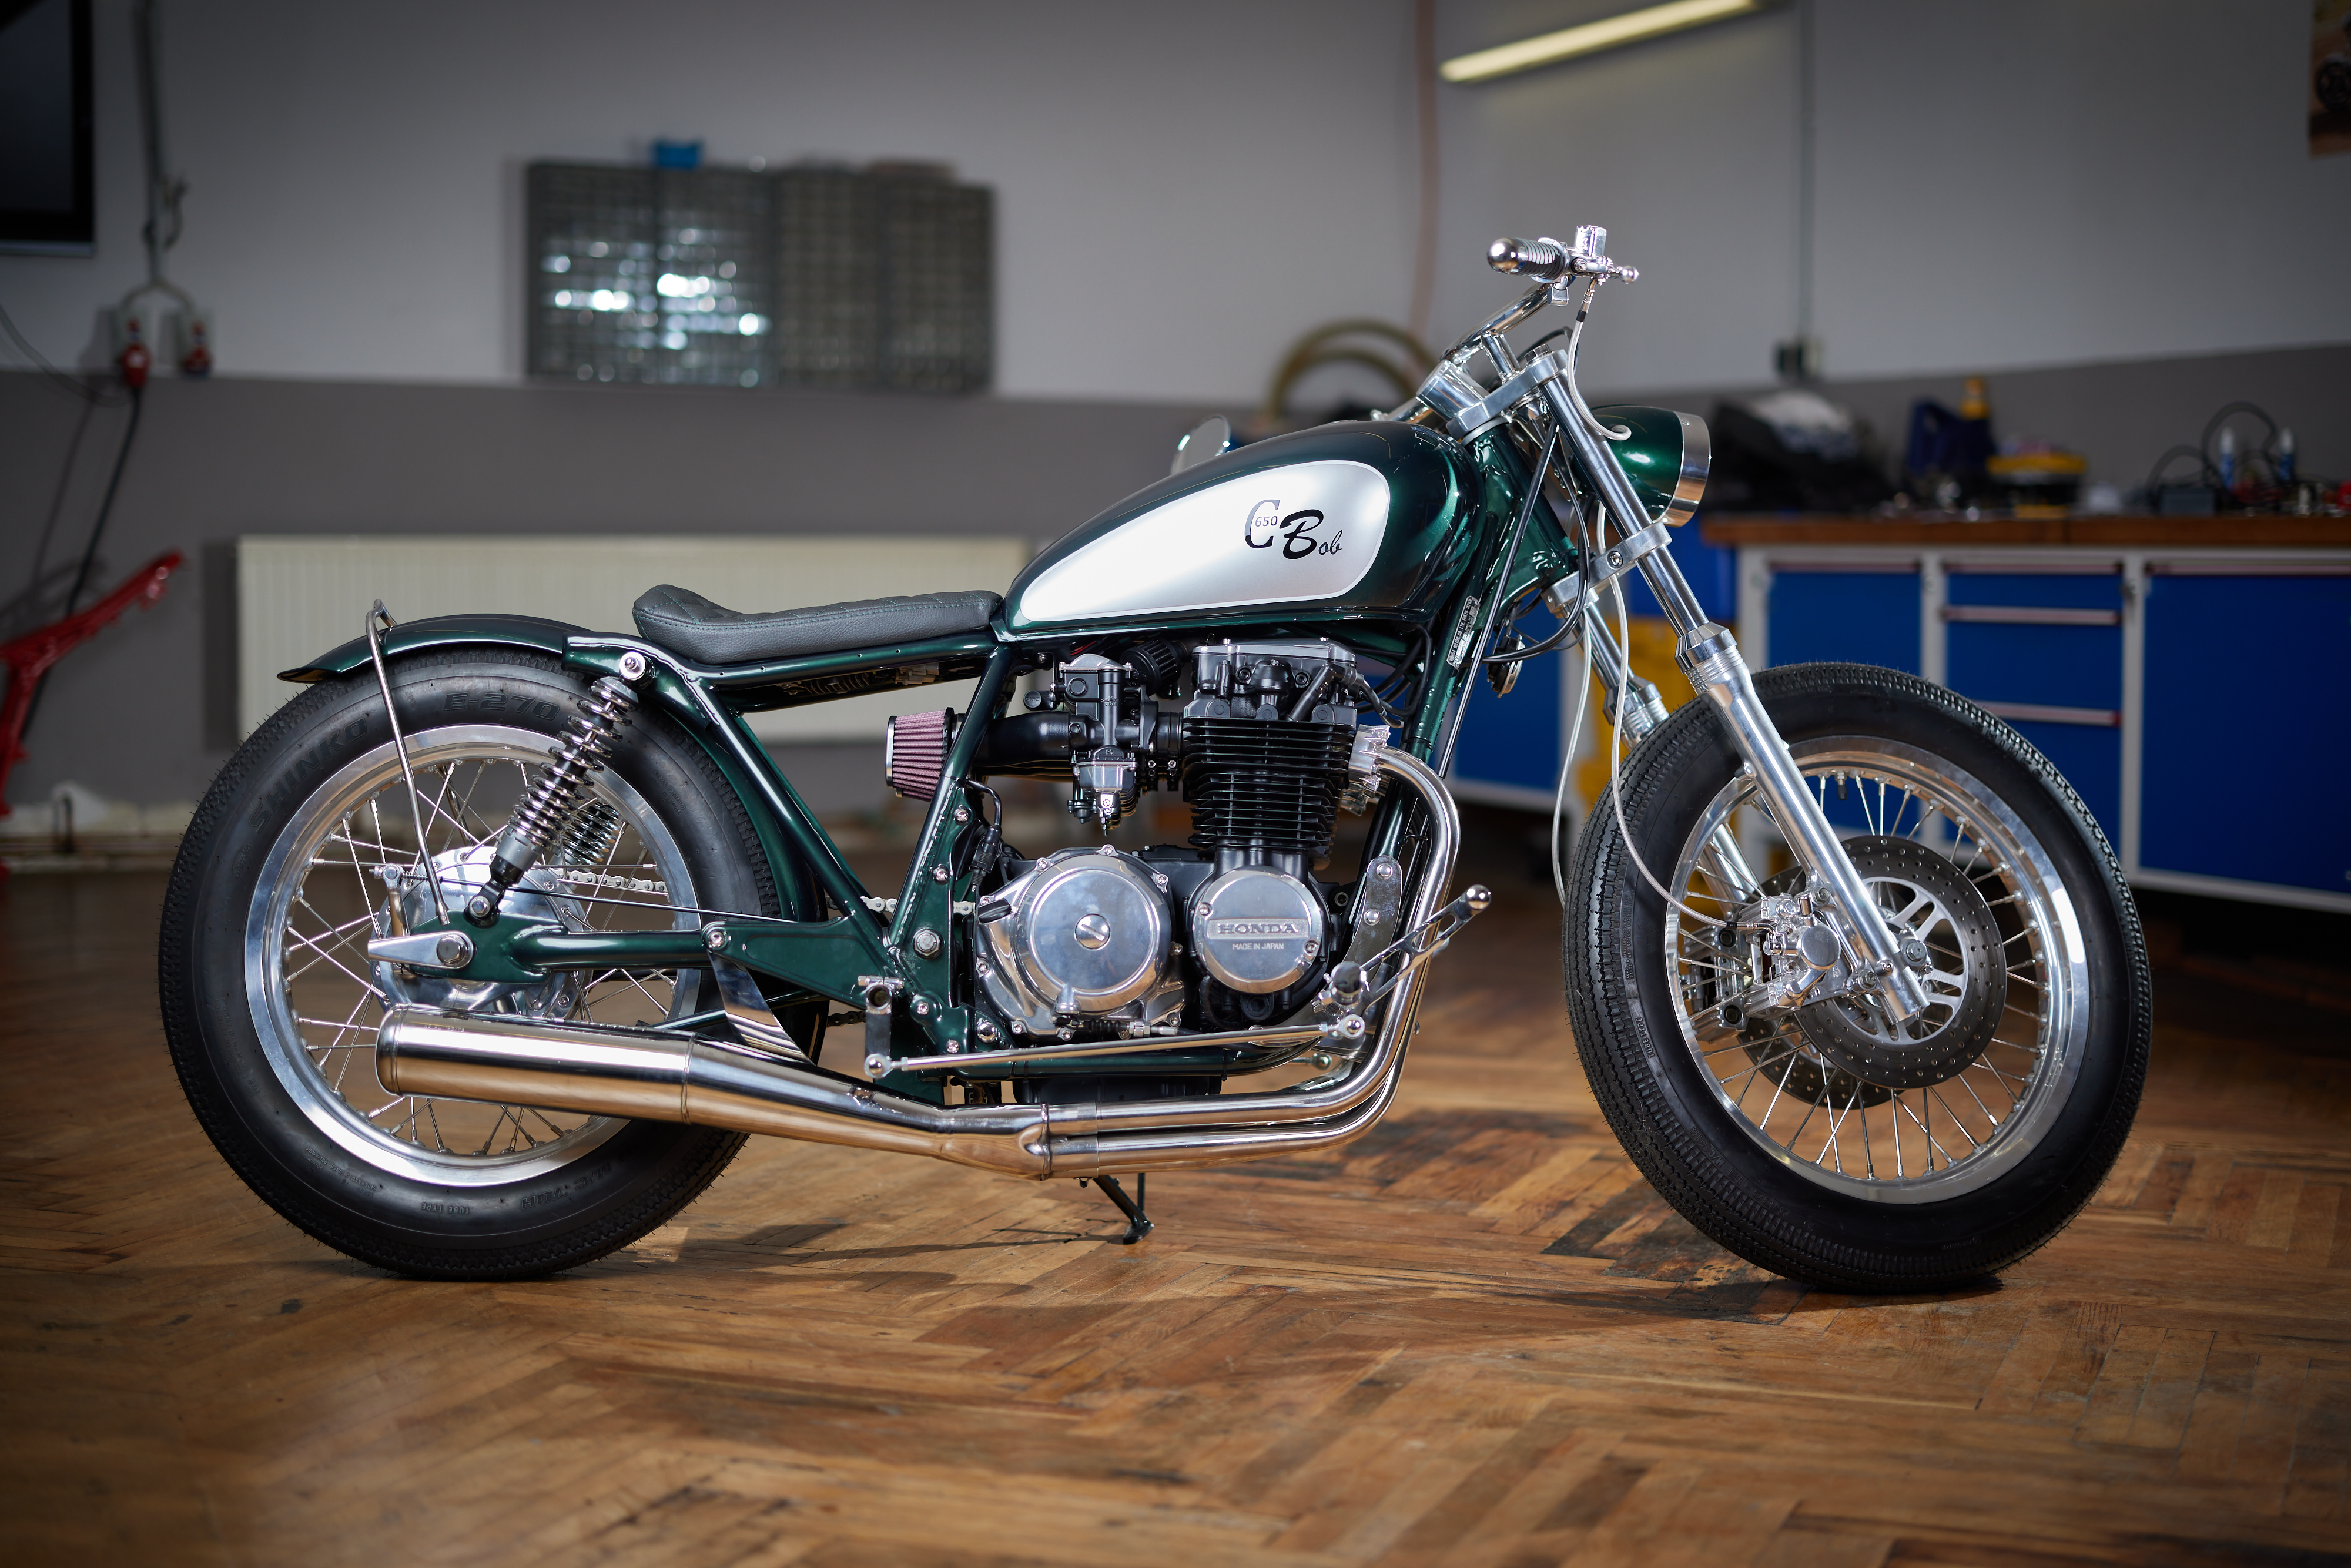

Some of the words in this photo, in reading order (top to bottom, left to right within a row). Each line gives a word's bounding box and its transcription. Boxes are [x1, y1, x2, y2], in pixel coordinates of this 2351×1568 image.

[1255, 515, 1278, 527] 650
[444, 692, 560, 721] E-270
[249, 718, 367, 835] SHINKO
[654, 770, 667, 786] E-270
[669, 800, 681, 815] KOREA
[1217, 923, 1299, 934] HONDA
[1636, 1017, 1646, 1037] TYPE
[1642, 1038, 1655, 1058] TUBE
[1689, 1127, 1708, 1148] 61H
[301, 1152, 324, 1170] POLYAMIDE
[306, 1146, 329, 1164] POLYAMIDE
[1709, 1149, 1725, 1167] M/C
[330, 1164, 345, 1175] PLIES
[574, 1162, 613, 1190] M/C
[521, 1187, 568, 1209] 70H
[422, 1202, 443, 1213] TYPE
[448, 1206, 469, 1214] TUBE
